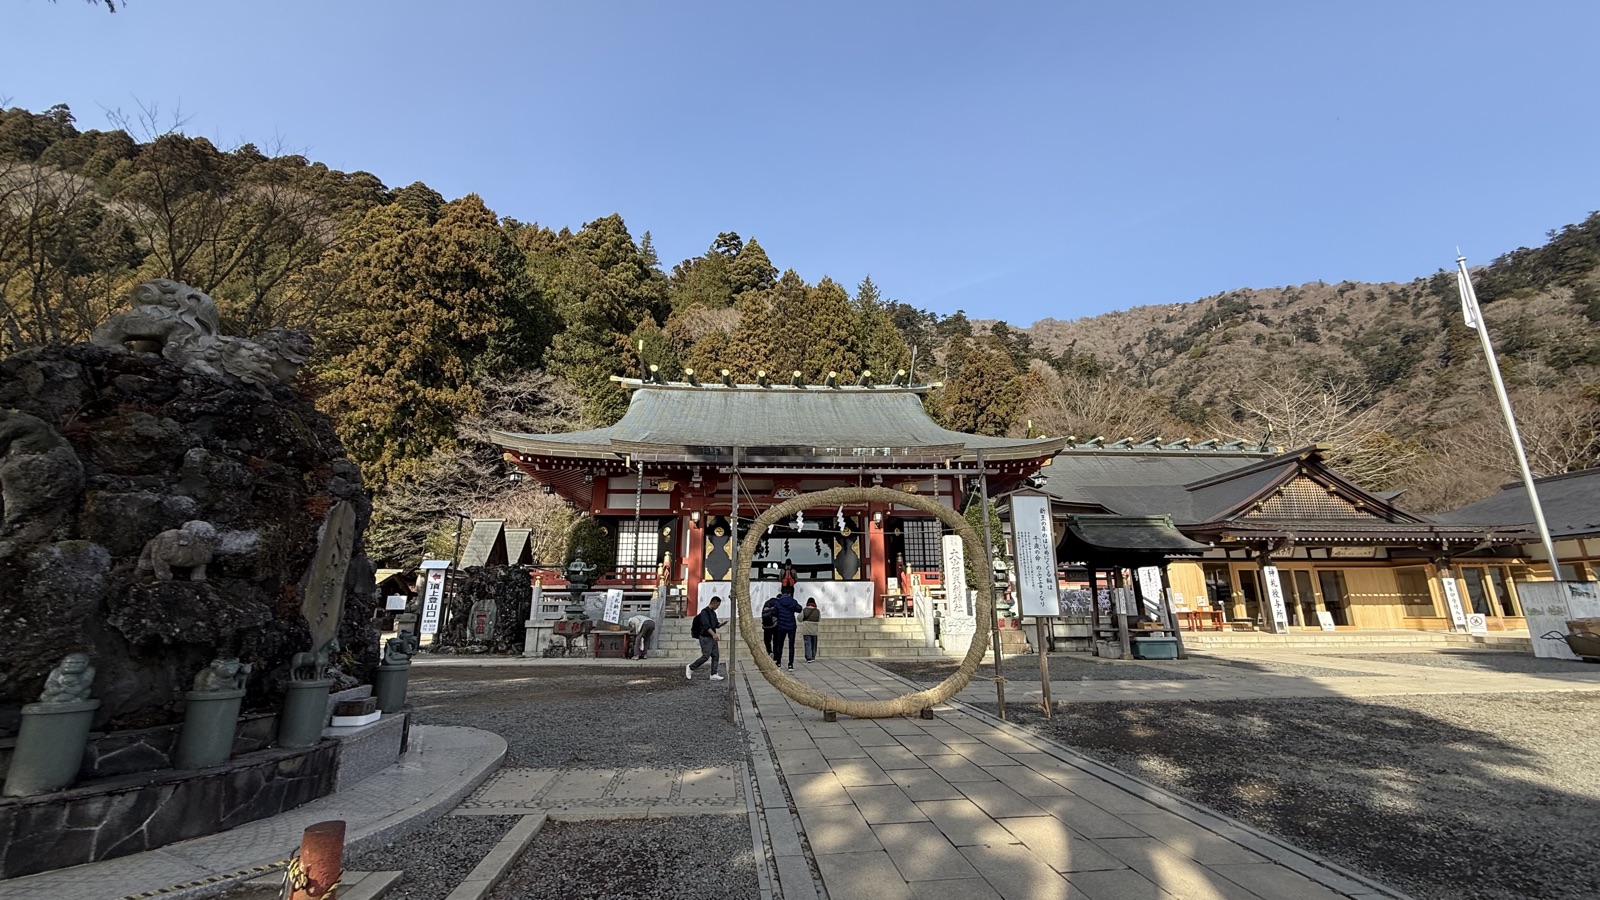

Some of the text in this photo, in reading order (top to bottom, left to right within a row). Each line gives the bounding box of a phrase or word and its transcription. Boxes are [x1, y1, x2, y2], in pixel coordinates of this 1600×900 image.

[426, 582, 440, 618] 頂上登山口
